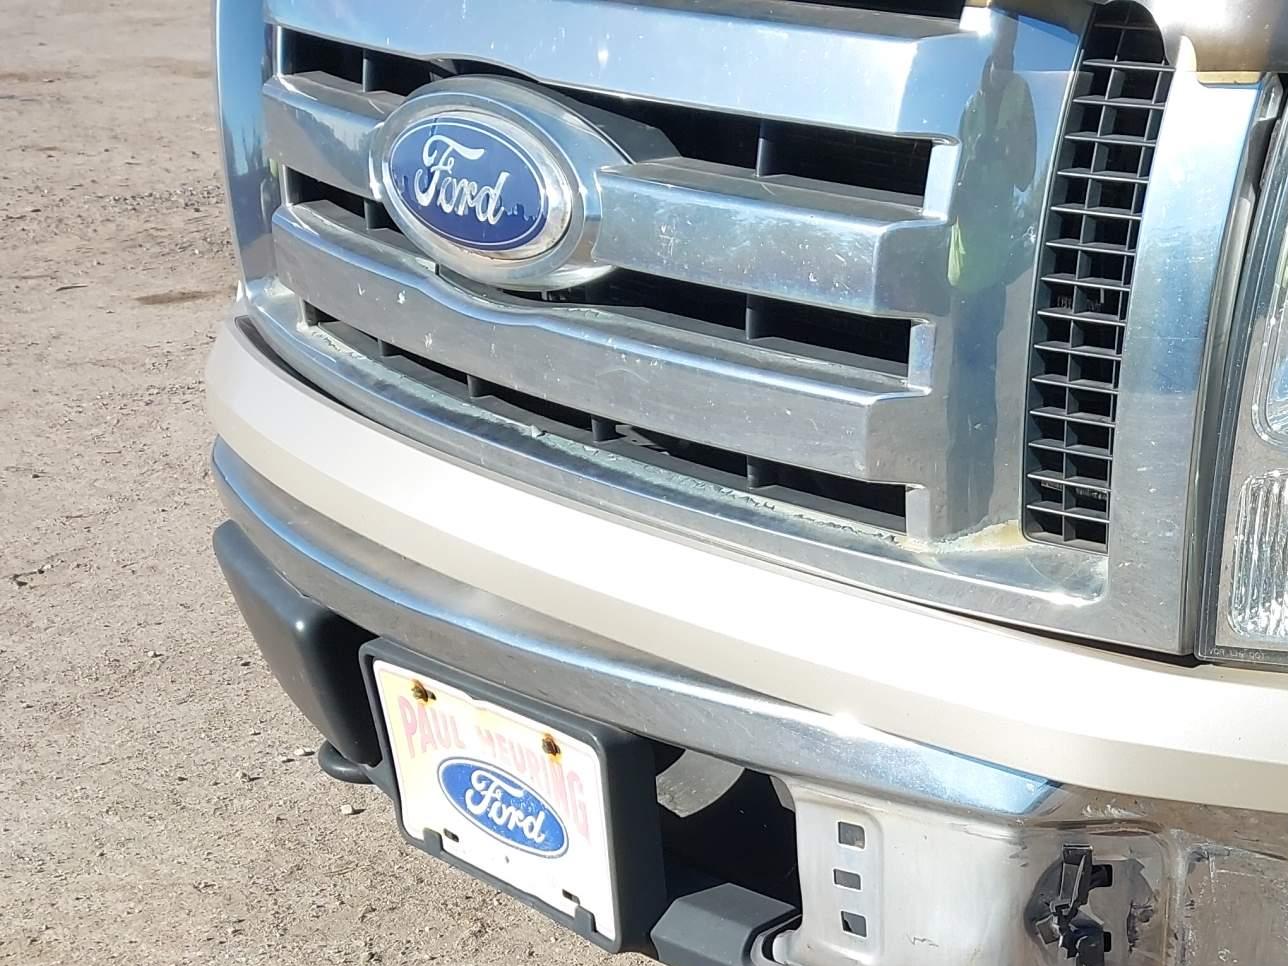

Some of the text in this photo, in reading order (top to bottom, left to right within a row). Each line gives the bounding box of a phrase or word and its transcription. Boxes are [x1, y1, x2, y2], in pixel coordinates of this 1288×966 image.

[414, 134, 512, 225] Ford
[397, 696, 465, 759] PAUL
[465, 769, 546, 843] Ford
